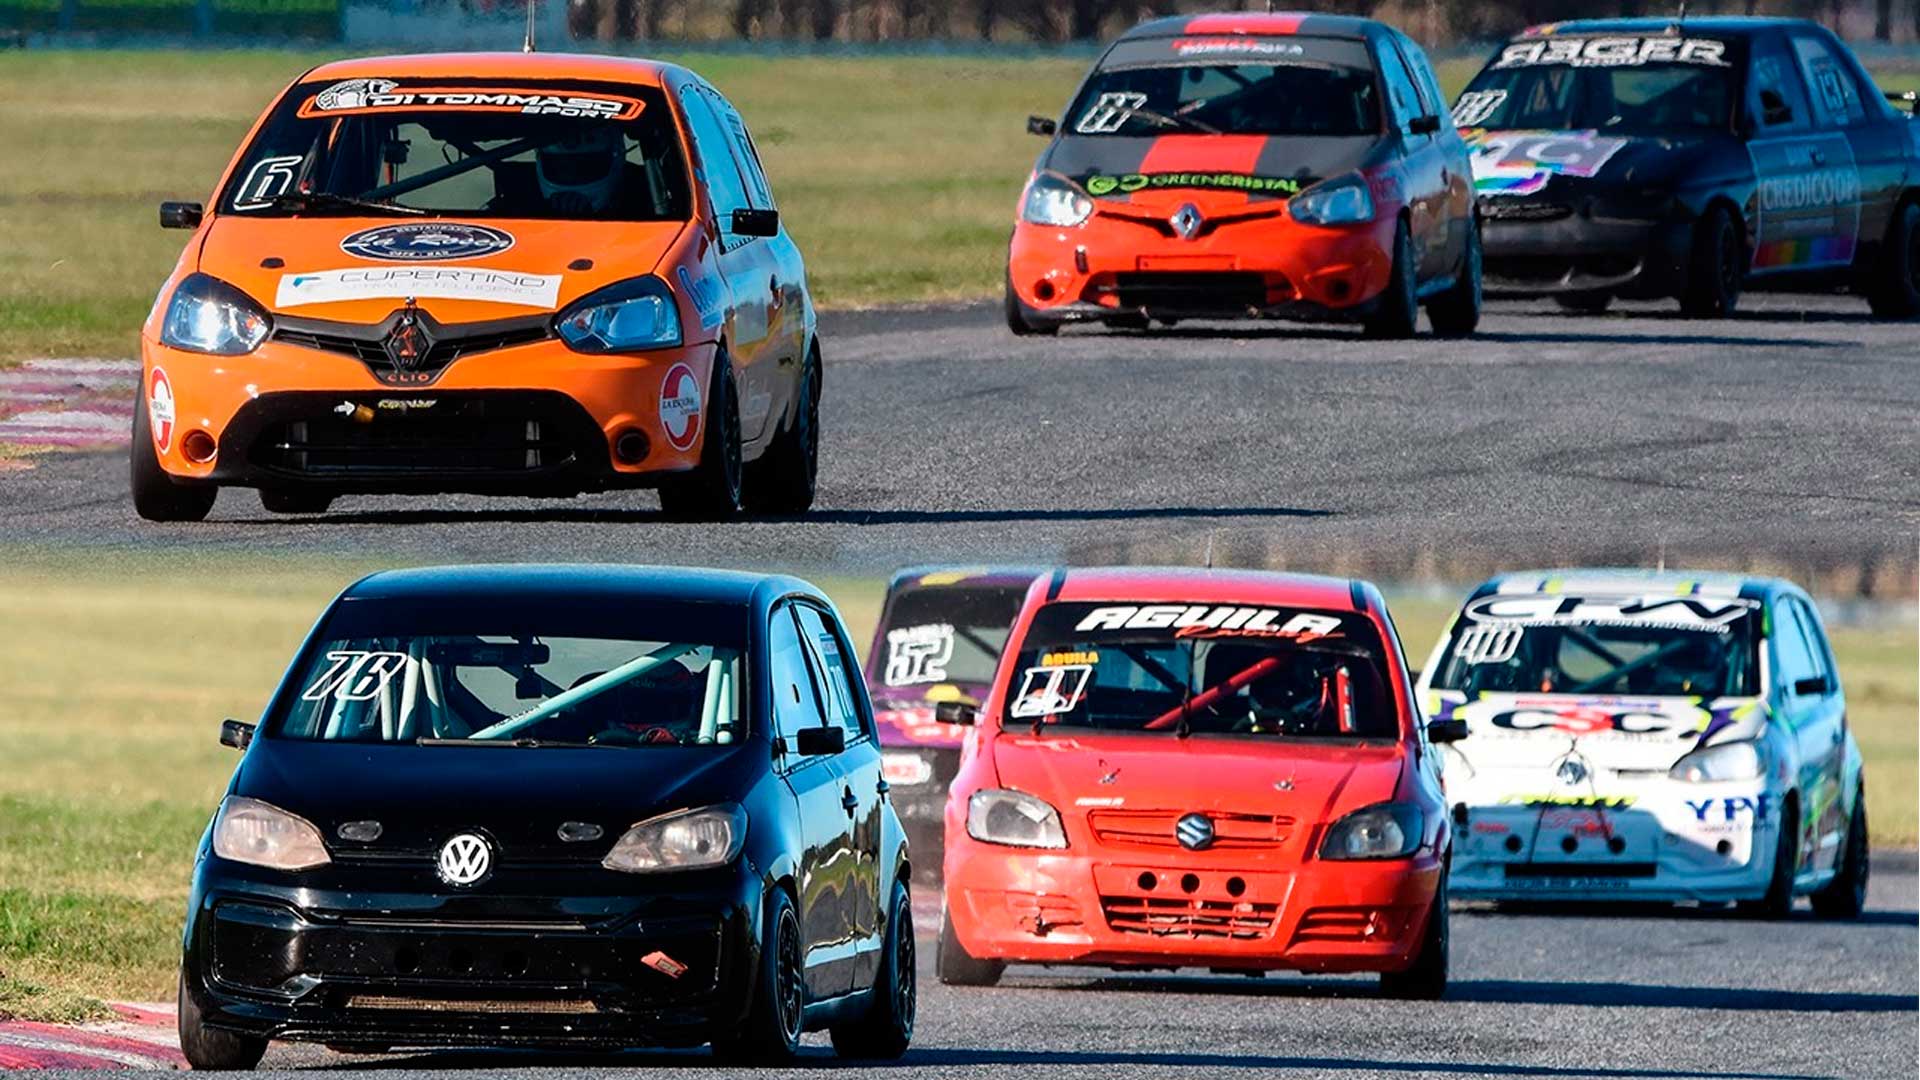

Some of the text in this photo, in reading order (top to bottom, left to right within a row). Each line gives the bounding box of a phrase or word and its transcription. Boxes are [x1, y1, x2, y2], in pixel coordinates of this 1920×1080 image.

[521, 105, 619, 119] SPORT
[232, 155, 304, 211] 6
[339, 269, 546, 288] CUPERTINO
[387, 373, 430, 382] CLIO
[1075, 605, 1343, 636] AGUILA
[1041, 652, 1099, 667] AGUILA
[1686, 792, 1774, 820] YPF
